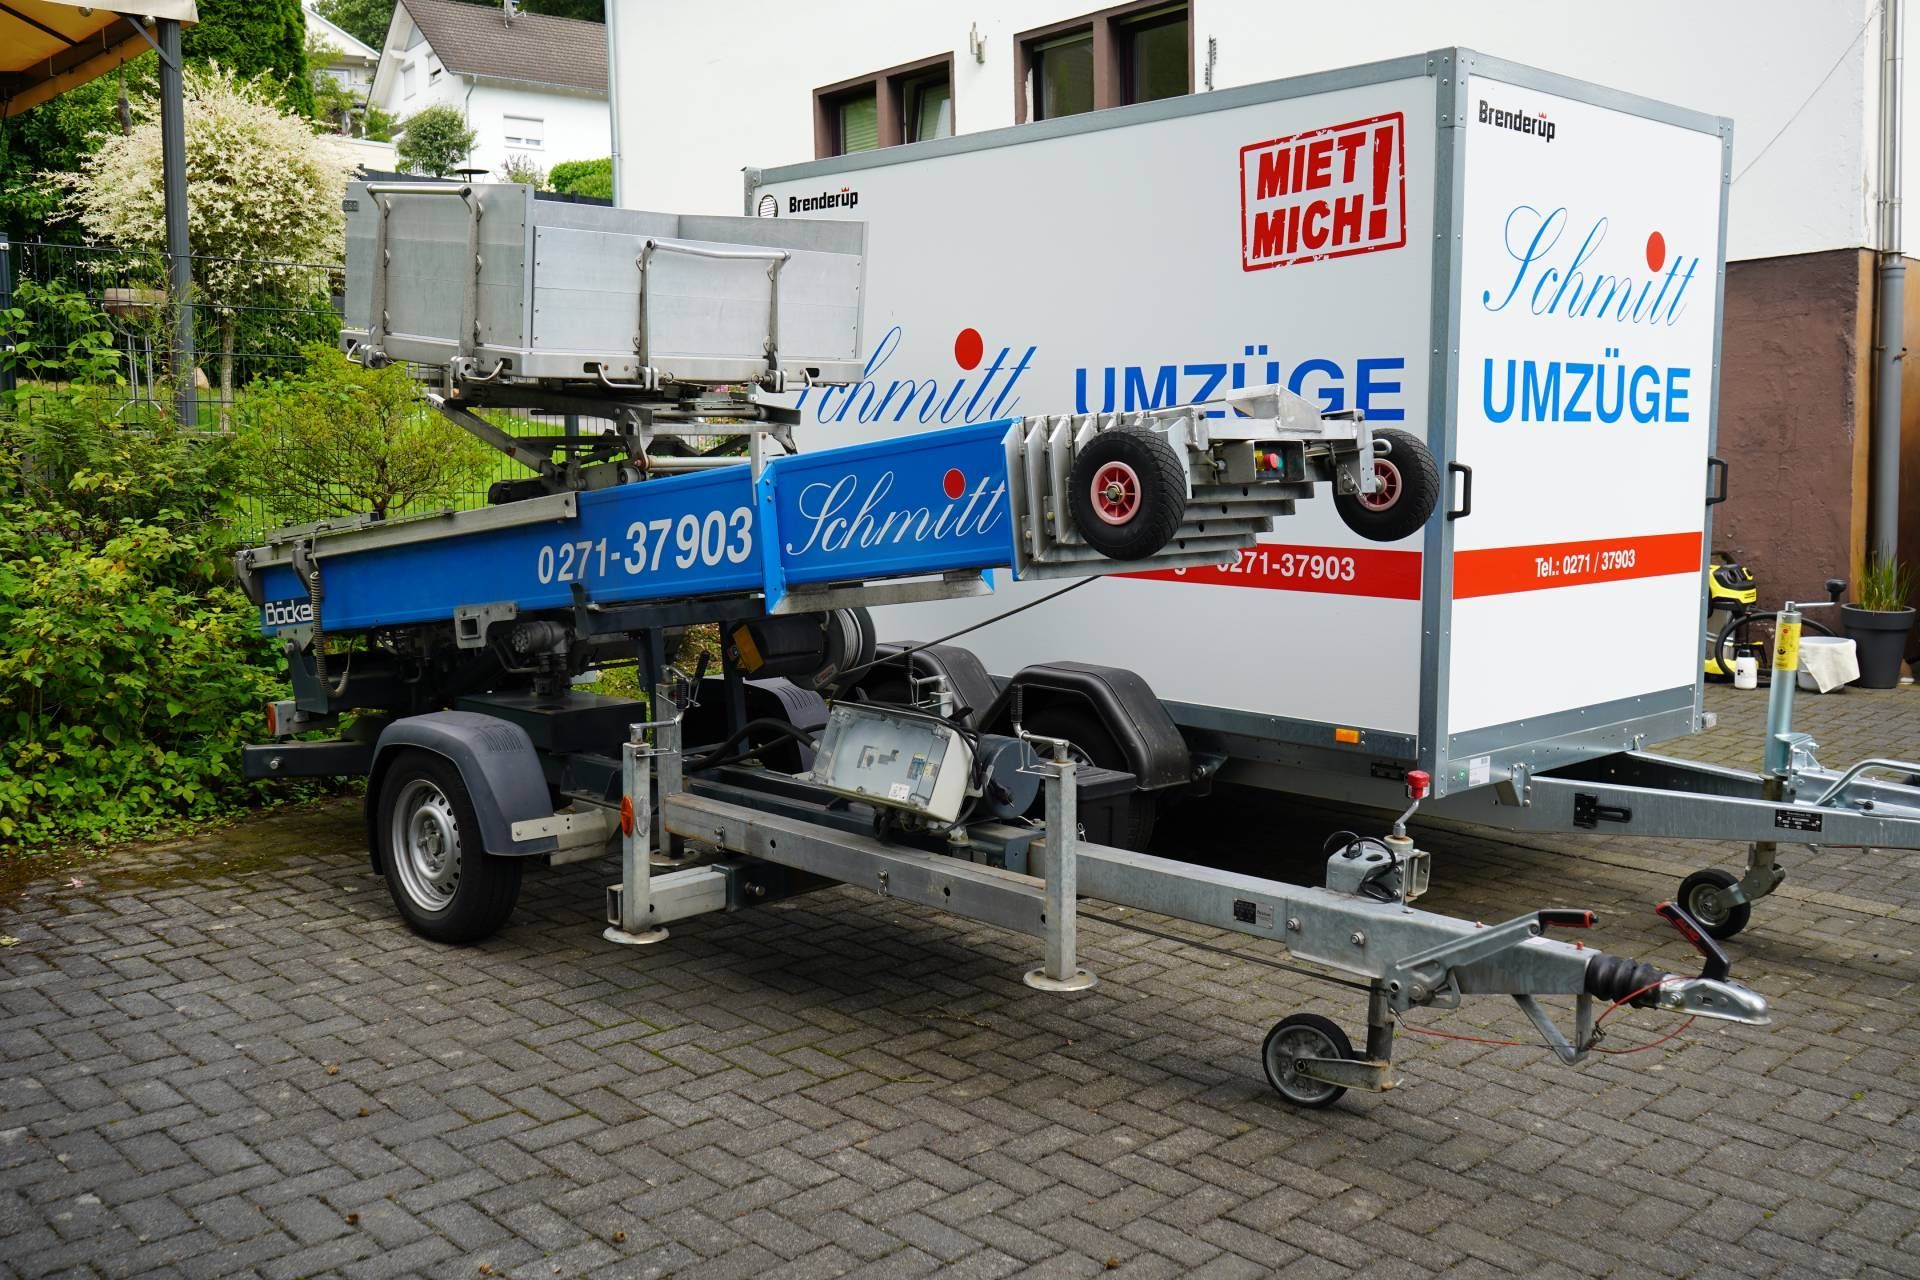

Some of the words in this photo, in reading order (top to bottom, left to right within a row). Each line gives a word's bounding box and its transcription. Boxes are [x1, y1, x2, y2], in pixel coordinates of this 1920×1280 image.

[1256, 132, 1367, 200] MIET
[1483, 205, 1699, 325] Schmitt
[795, 326, 1038, 424] chmitt
[1075, 344, 1405, 421] UMZÜGE
[1483, 348, 1692, 423] UMZÜGE
[537, 506, 753, 585] 0271-37903
[786, 468, 1009, 555] Schmitt
[1535, 556, 1560, 578] Tel.:
[1562, 551, 1591, 575] 0271
[1594, 551, 1600, 573] /
[1601, 549, 1635, 570] 37903
